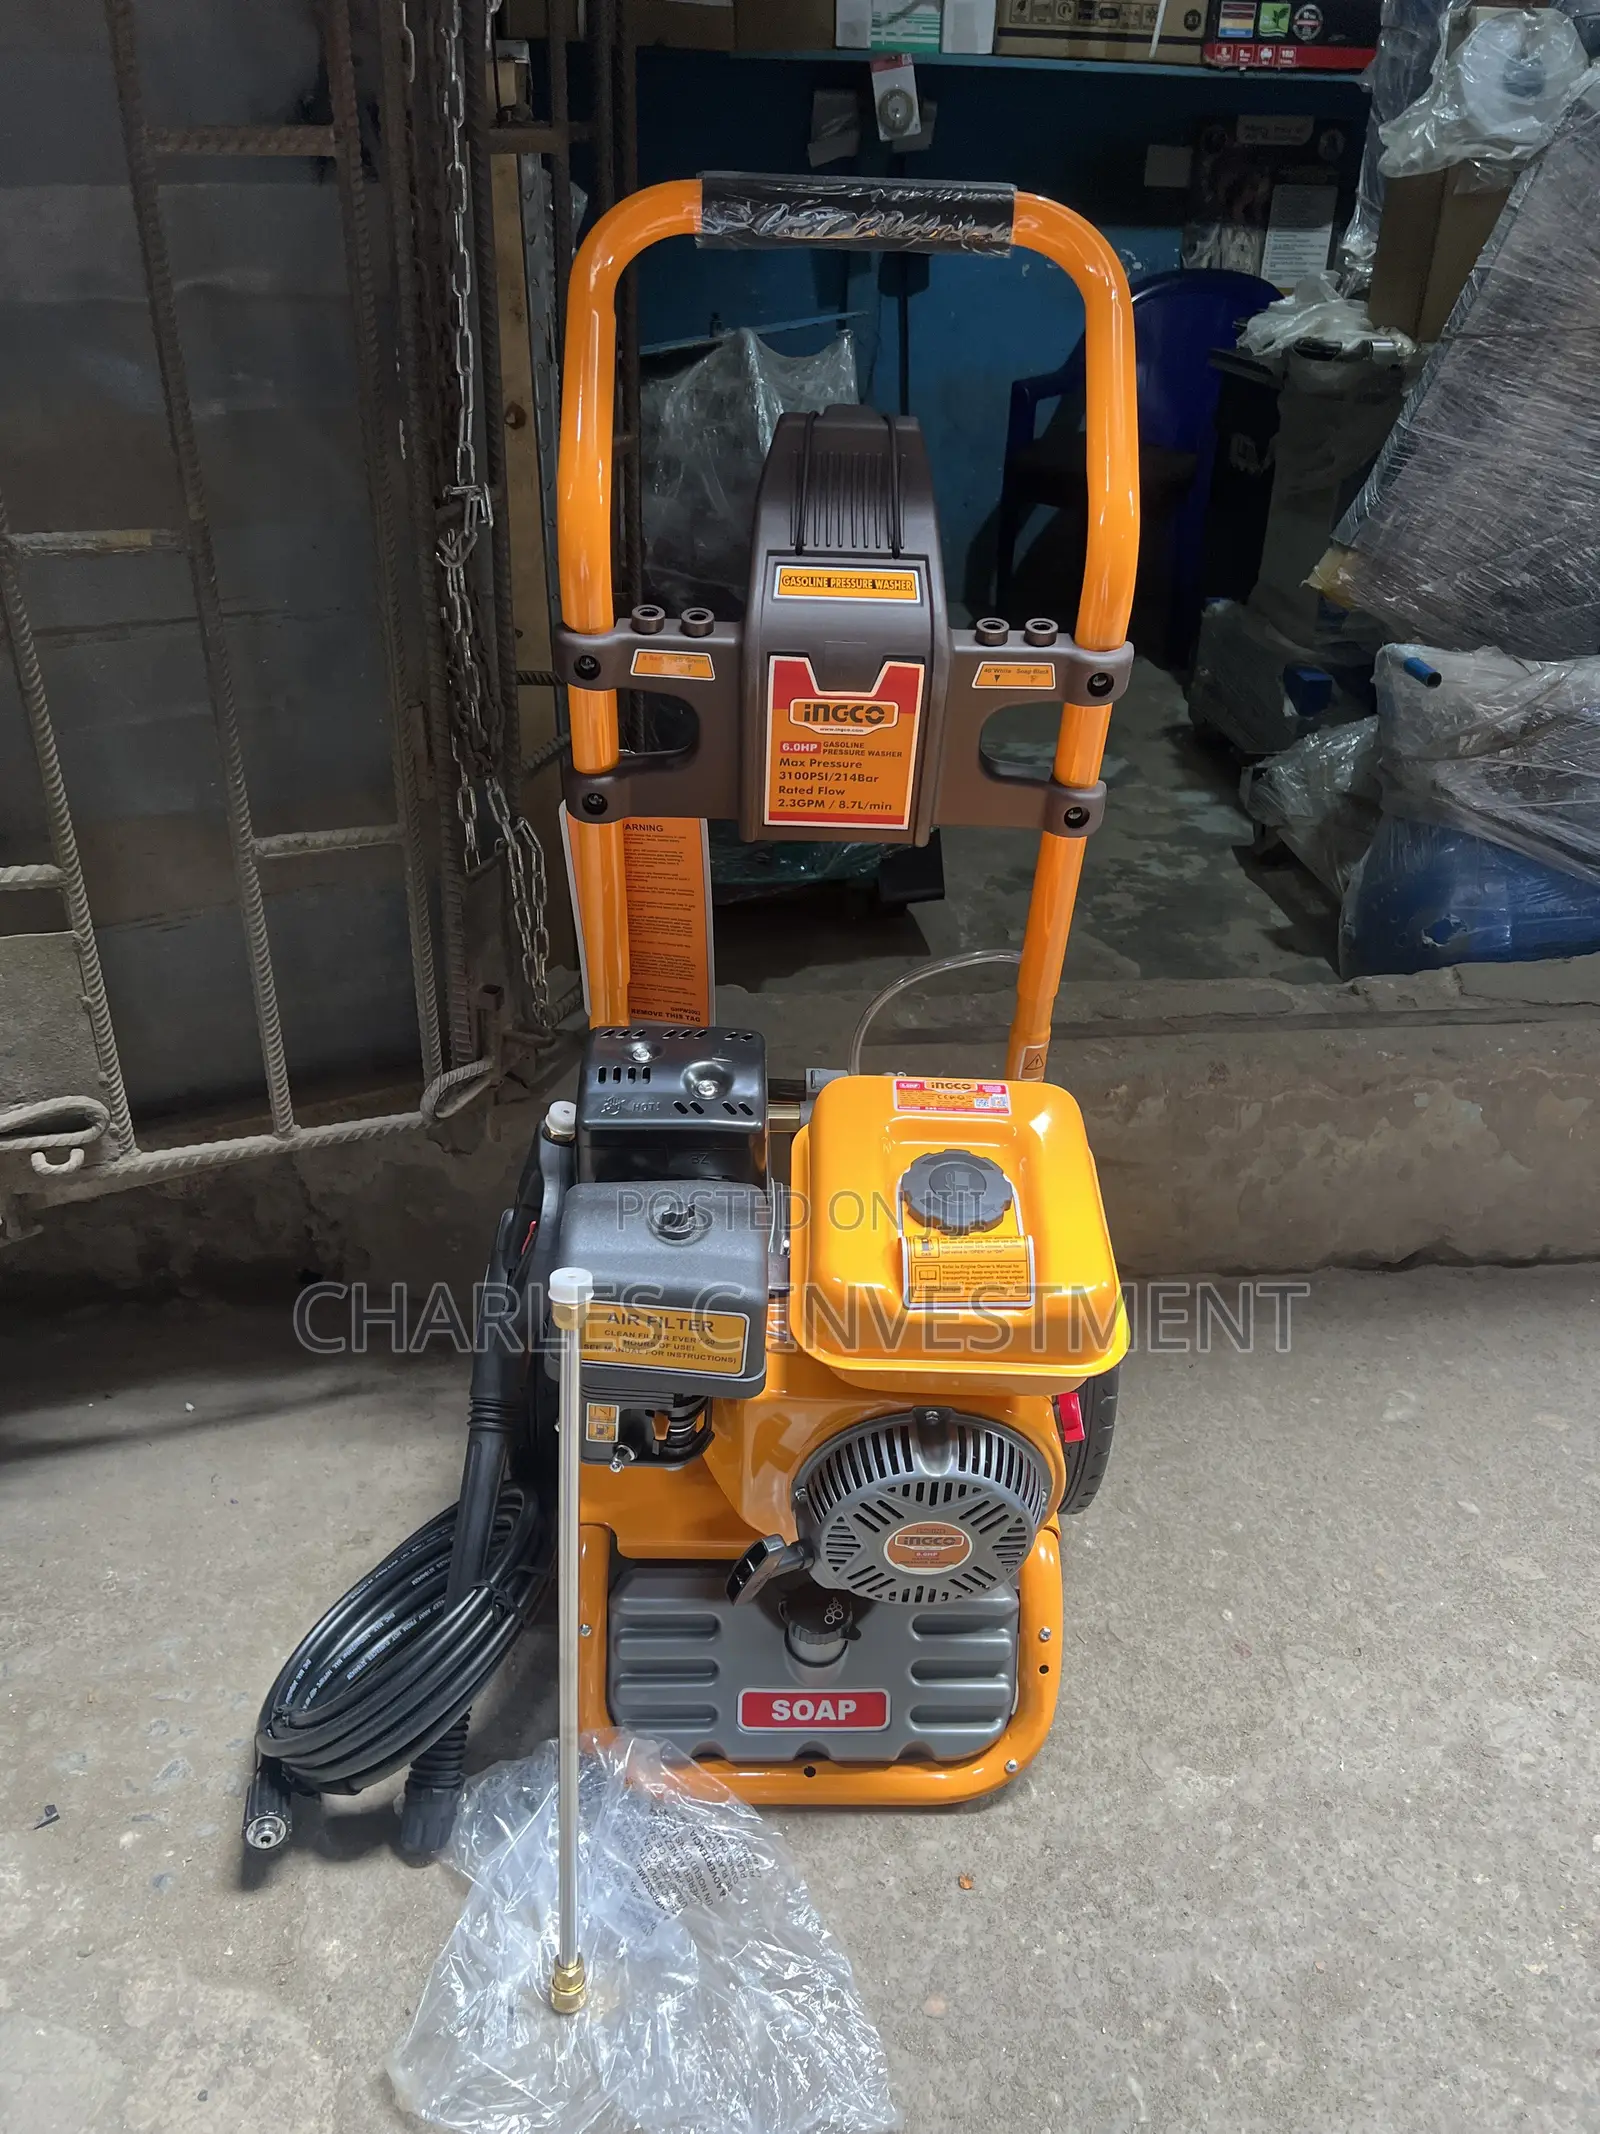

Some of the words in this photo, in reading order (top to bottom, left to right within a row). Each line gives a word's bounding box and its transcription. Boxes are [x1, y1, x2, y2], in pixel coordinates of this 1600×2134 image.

[782, 576, 828, 588] GASOLINE
[830, 578, 873, 590] PRESSURE
[874, 580, 913, 591] WASHER
[804, 704, 885, 724] INGCO
[782, 743, 818, 752] 6.0HP
[868, 750, 902, 758] WASHER
[780, 758, 804, 767] Max
[810, 758, 862, 768] Pressure
[779, 772, 879, 783] 3100PSI/214Bar
[778, 786, 813, 795] Rated
[818, 786, 845, 796] Flow
[778, 798, 825, 808] 2.3GPM
[828, 800, 835, 809] /
[838, 800, 892, 810] 8.7L/min
[623, 824, 664, 832] ARNING
[630, 1008, 662, 1018] REMOVE
[665, 1012, 683, 1020] THIS
[632, 1102, 660, 1112] HOT!
[607, 1312, 640, 1326] AIR
[647, 1316, 714, 1332] FILTER
[604, 1330, 635, 1338] CLEAN
[624, 1339, 656, 1347] HOURS
[659, 1342, 672, 1350] OF
[604, 1345, 642, 1355] MANUAL
[645, 1349, 664, 1357] FOR
[666, 1351, 736, 1364] INSTRUCTIONS)
[904, 1536, 956, 1546] INGCO
[772, 1699, 857, 1721] SOAP
[654, 1840, 666, 1855] CE
[663, 1837, 679, 1857] NEZ
[675, 1855, 686, 1868] AU
[701, 1834, 732, 1878] PLASTICO
[686, 1860, 711, 1893] NOEUD
[701, 1891, 715, 1906] UN
